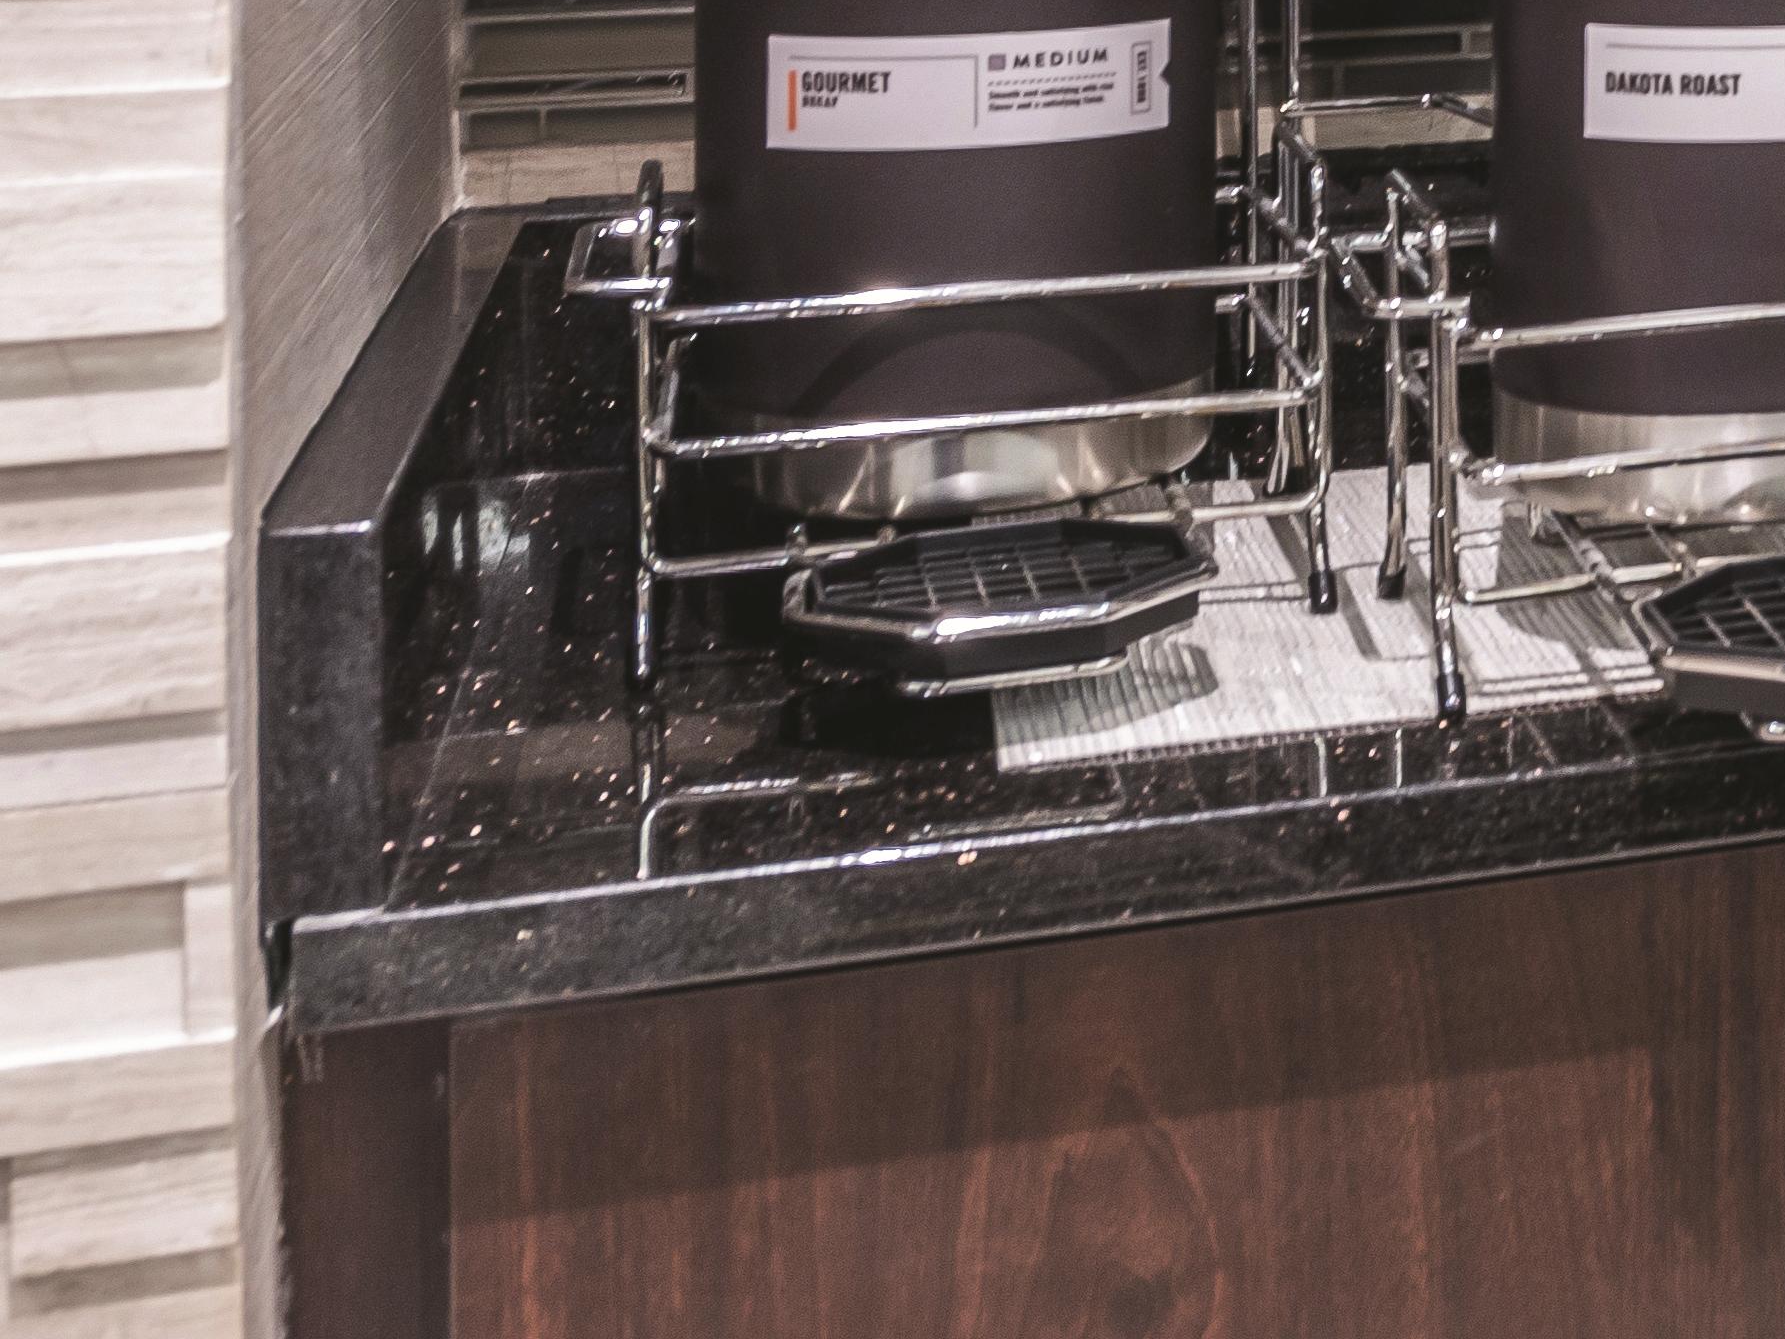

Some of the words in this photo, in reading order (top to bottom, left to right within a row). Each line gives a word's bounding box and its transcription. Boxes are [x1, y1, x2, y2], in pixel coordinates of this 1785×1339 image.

[1013, 48, 1108, 69] MEDIUM
[801, 71, 891, 94] GOURMET
[1605, 72, 1673, 94] DAKOTA
[1680, 74, 1741, 96] ROAST
